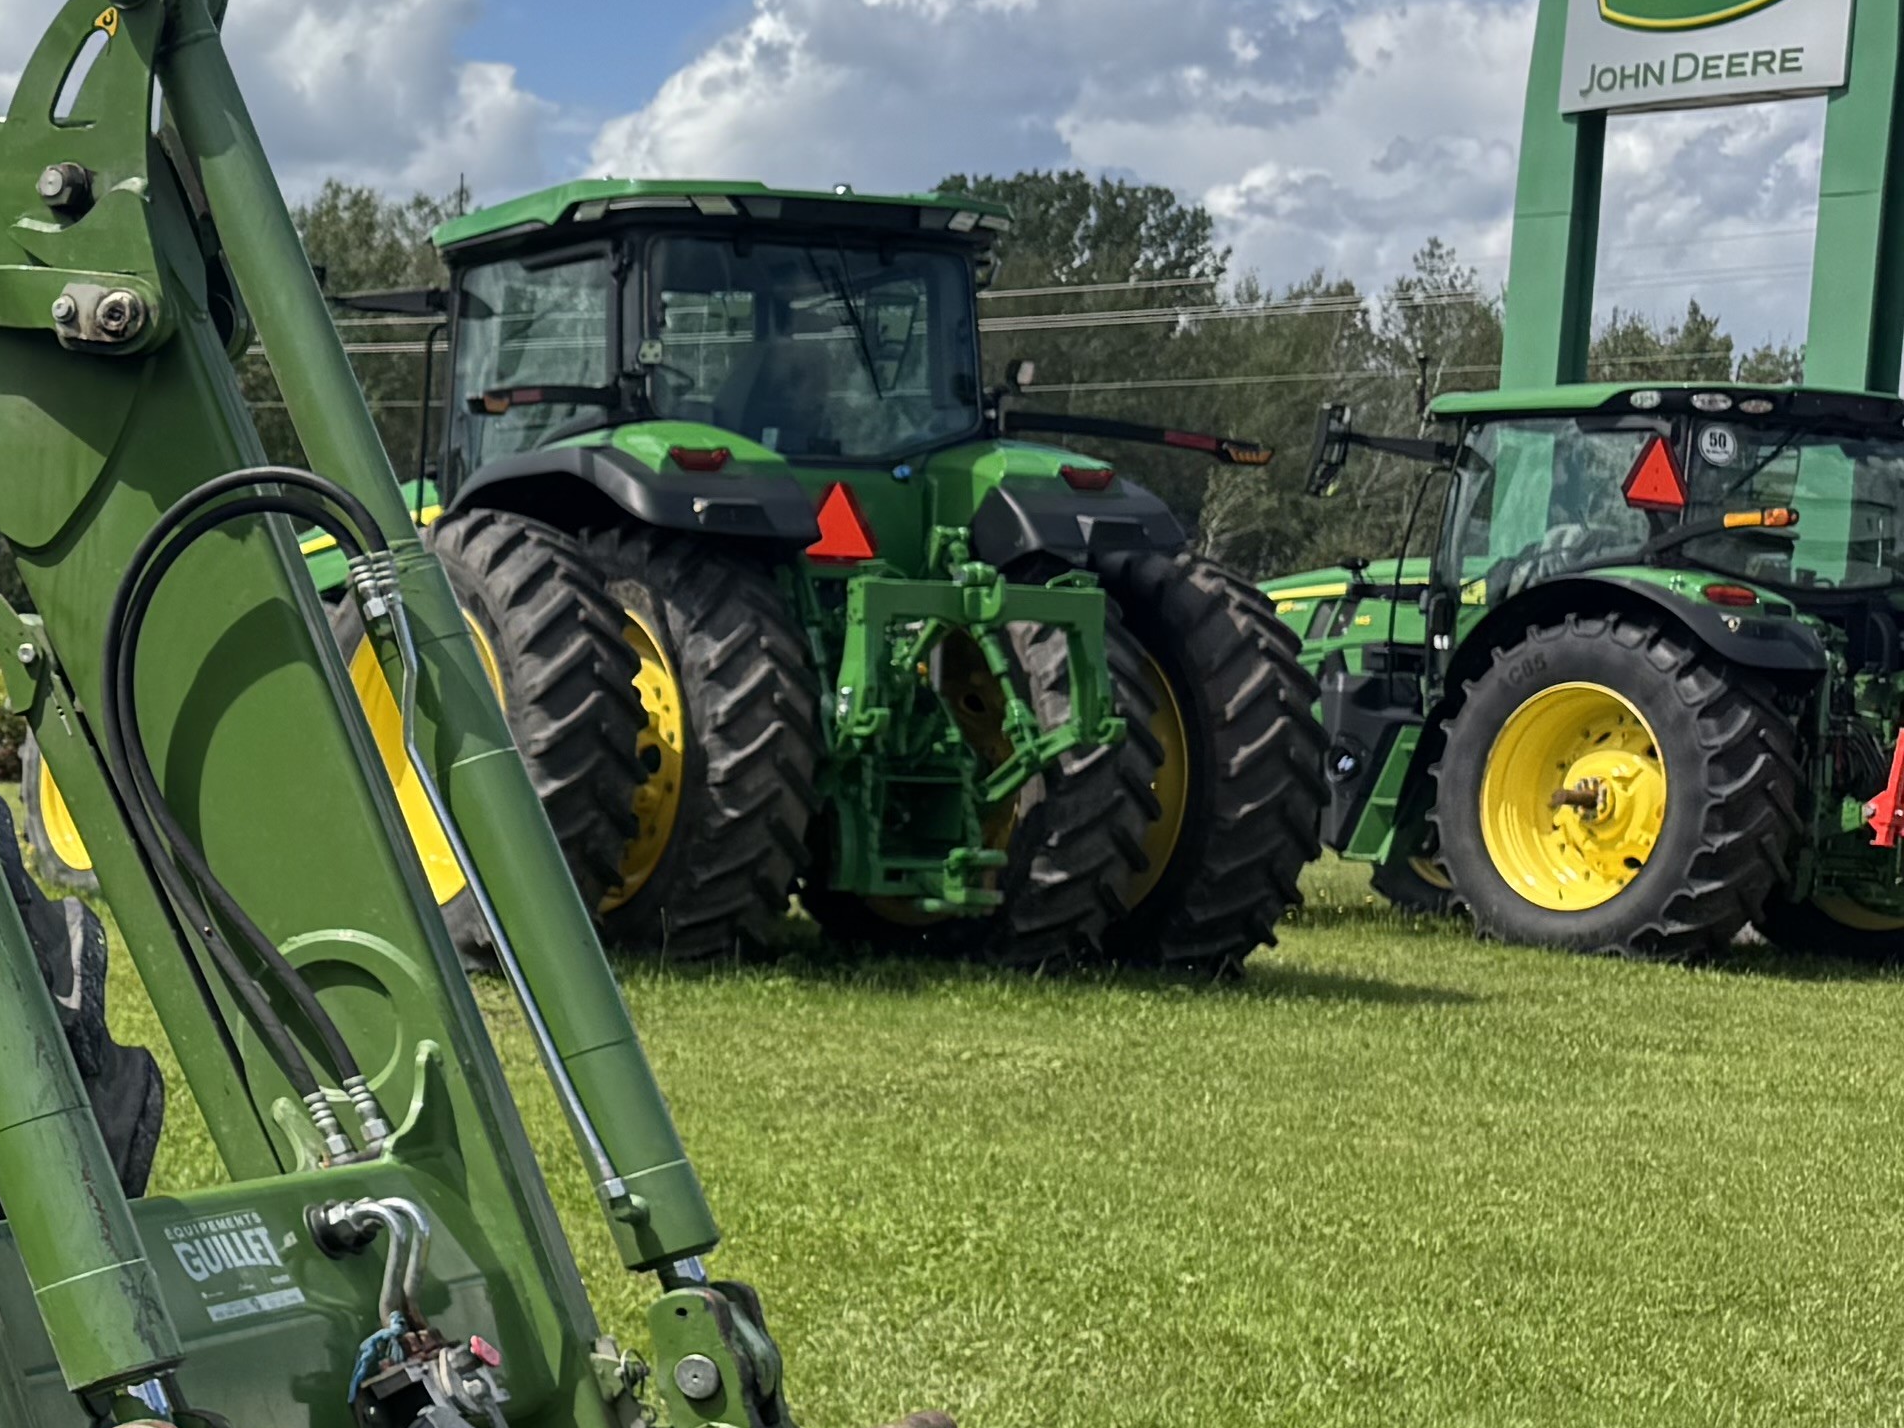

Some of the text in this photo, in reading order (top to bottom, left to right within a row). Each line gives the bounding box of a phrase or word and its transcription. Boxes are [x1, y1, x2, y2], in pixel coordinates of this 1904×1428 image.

[1579, 47, 1805, 97] JOHN DEERE
[171, 1226, 284, 1283] GUILLET
